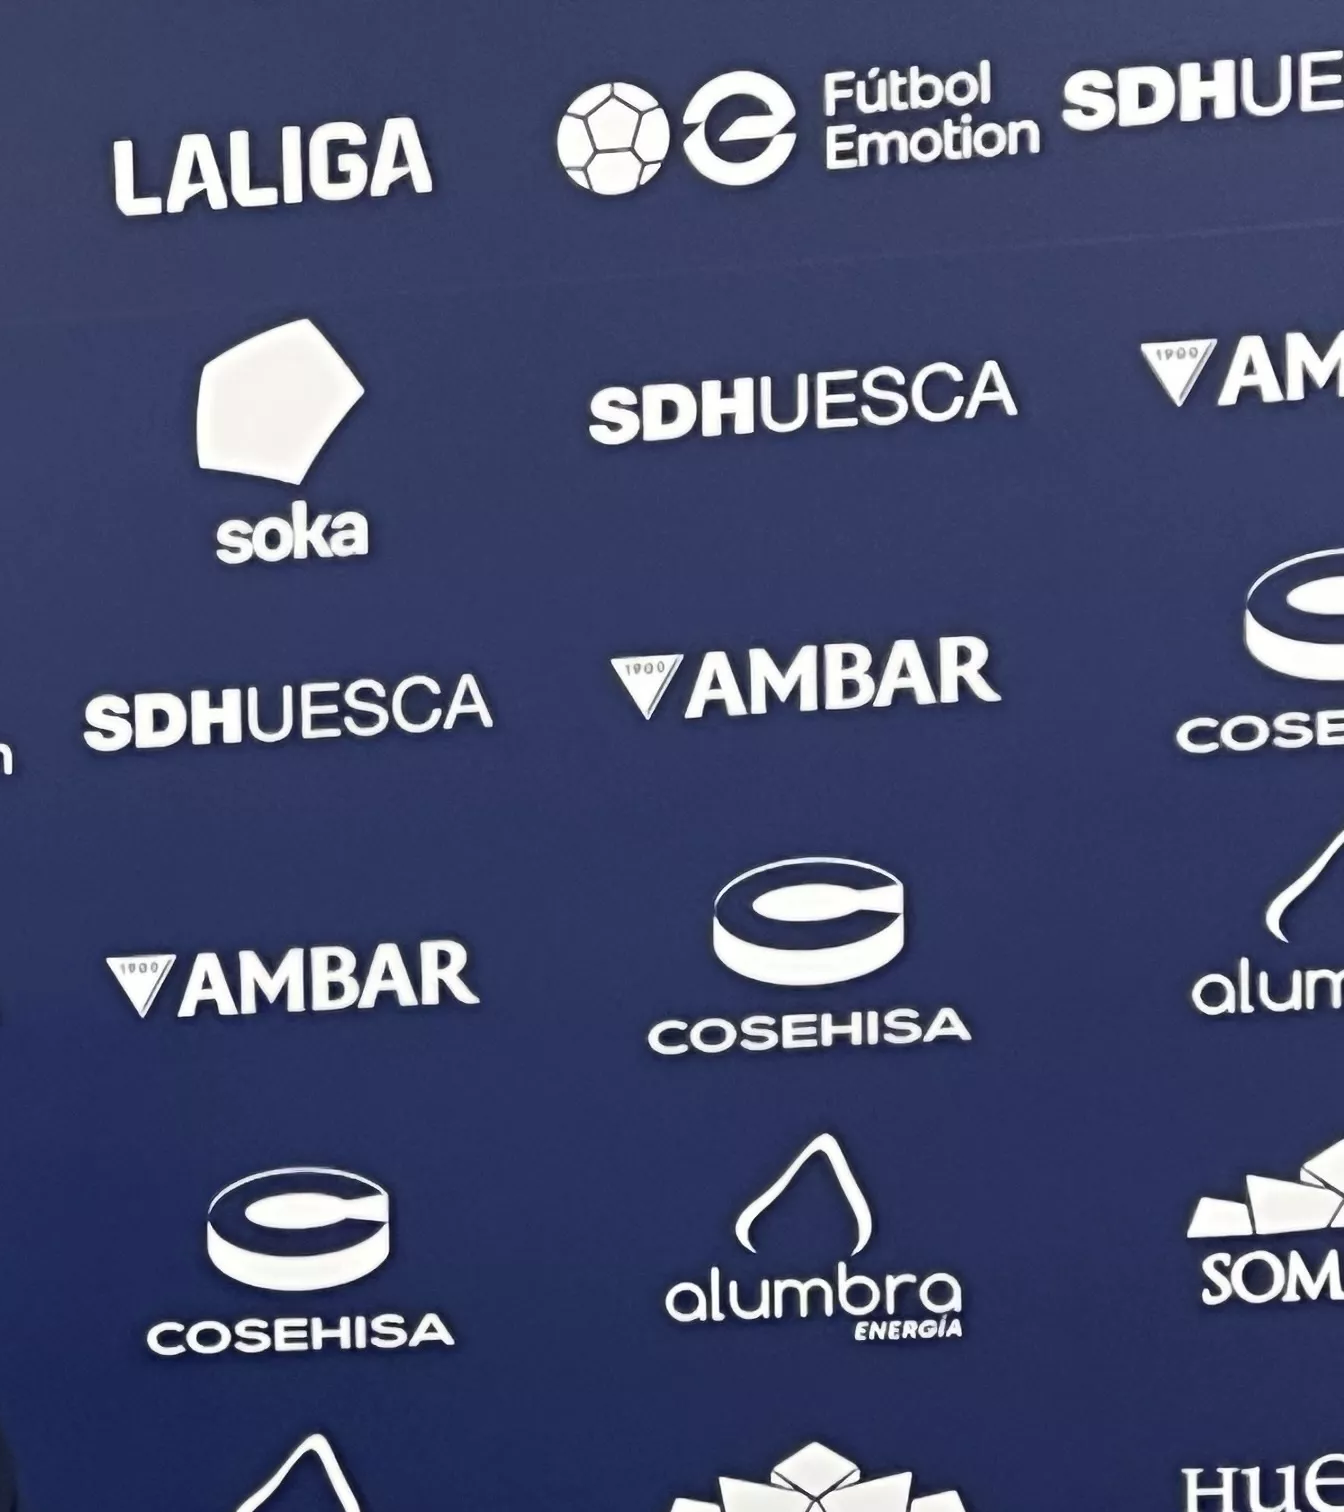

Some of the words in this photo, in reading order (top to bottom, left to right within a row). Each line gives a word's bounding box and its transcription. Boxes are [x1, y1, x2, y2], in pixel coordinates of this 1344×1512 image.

[824, 59, 991, 117] Fútbol
[1061, 49, 1344, 131] SDHUE
[113, 117, 433, 217] LALIGA
[826, 112, 1040, 170] Emotion
[588, 359, 1018, 445] SDHUESCA
[216, 499, 369, 565] soka
[684, 635, 1002, 719] AMBAR
[83, 673, 494, 752] SDHUESCA
[1175, 709, 1344, 754] COSE
[177, 939, 481, 1018] AMBAR
[647, 1007, 972, 1055] COSEHISA
[665, 1261, 962, 1322] alumbra
[1201, 1248, 1344, 1306] SOM
[146, 1312, 455, 1356] COSEHISA
[854, 1313, 963, 1341] ENERGÍA
